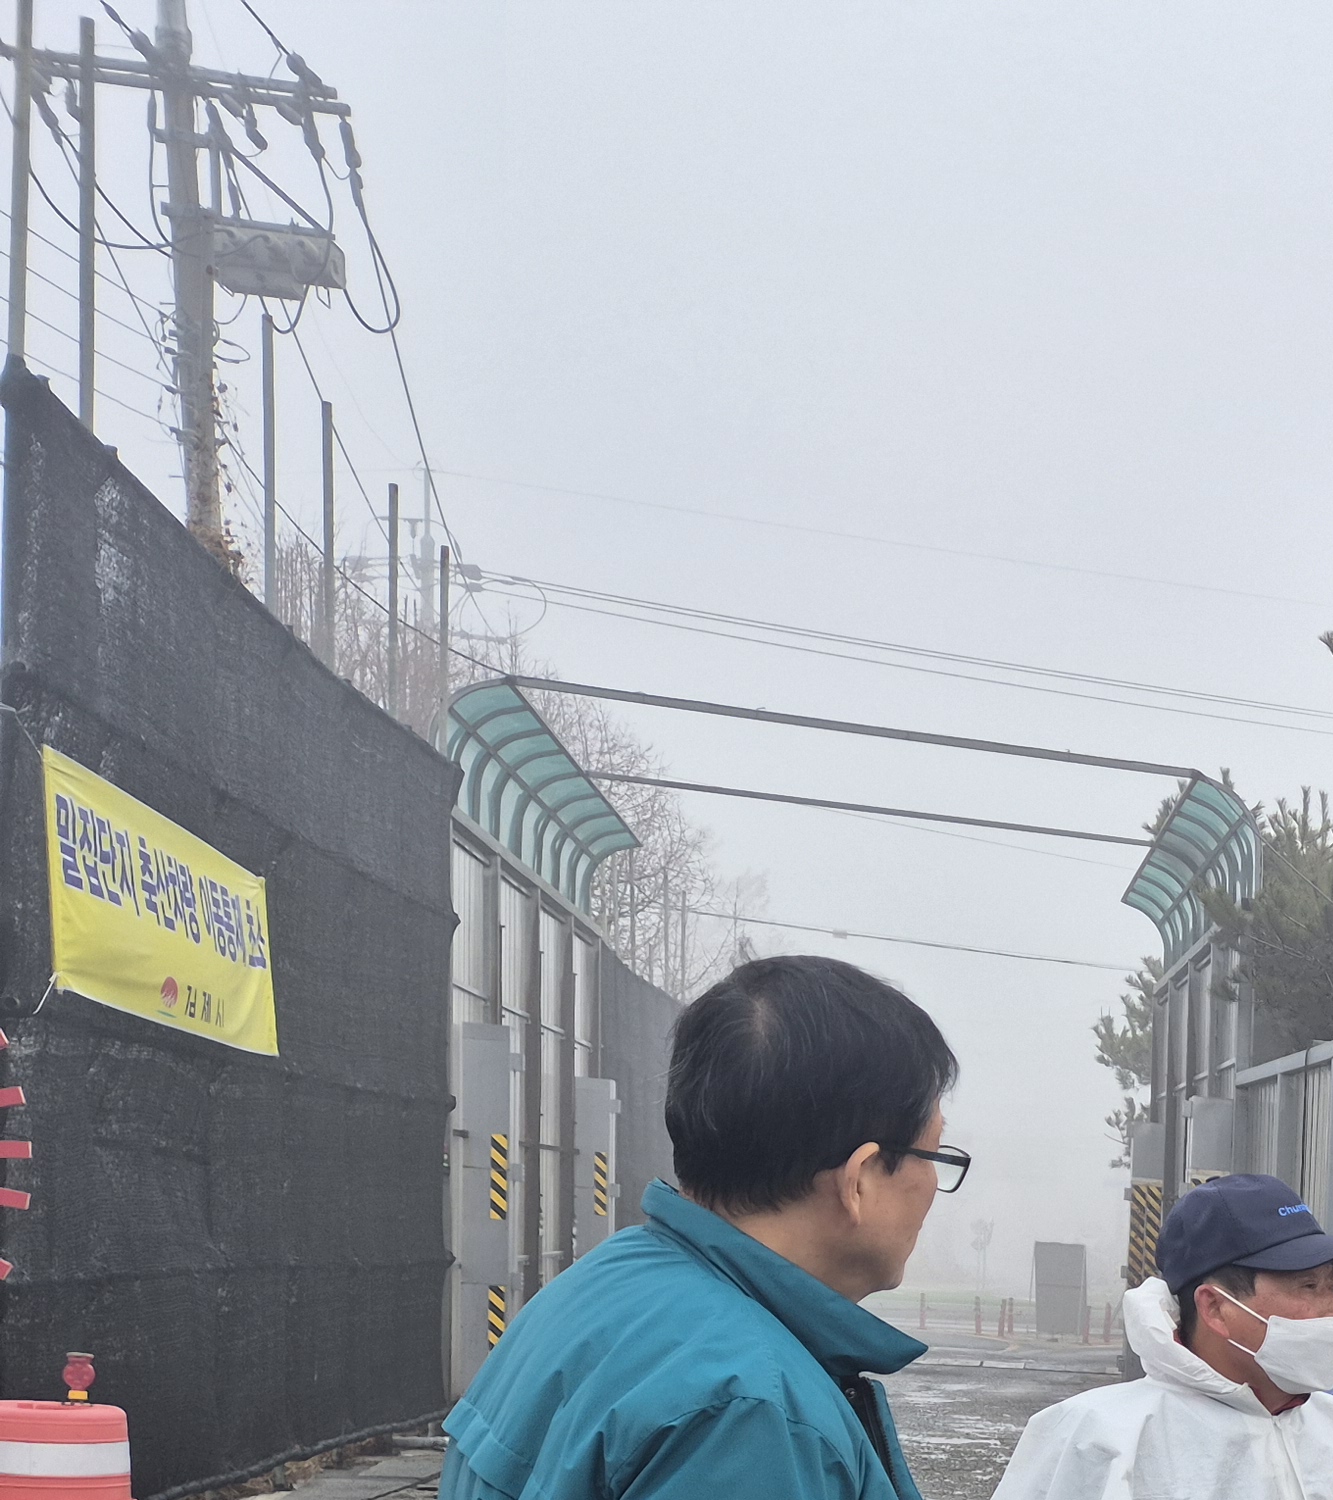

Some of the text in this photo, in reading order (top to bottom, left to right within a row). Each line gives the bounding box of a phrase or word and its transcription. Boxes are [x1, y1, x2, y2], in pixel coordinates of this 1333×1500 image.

[56, 793, 267, 969] 밀집단지 축산차량 이동통제 초소
